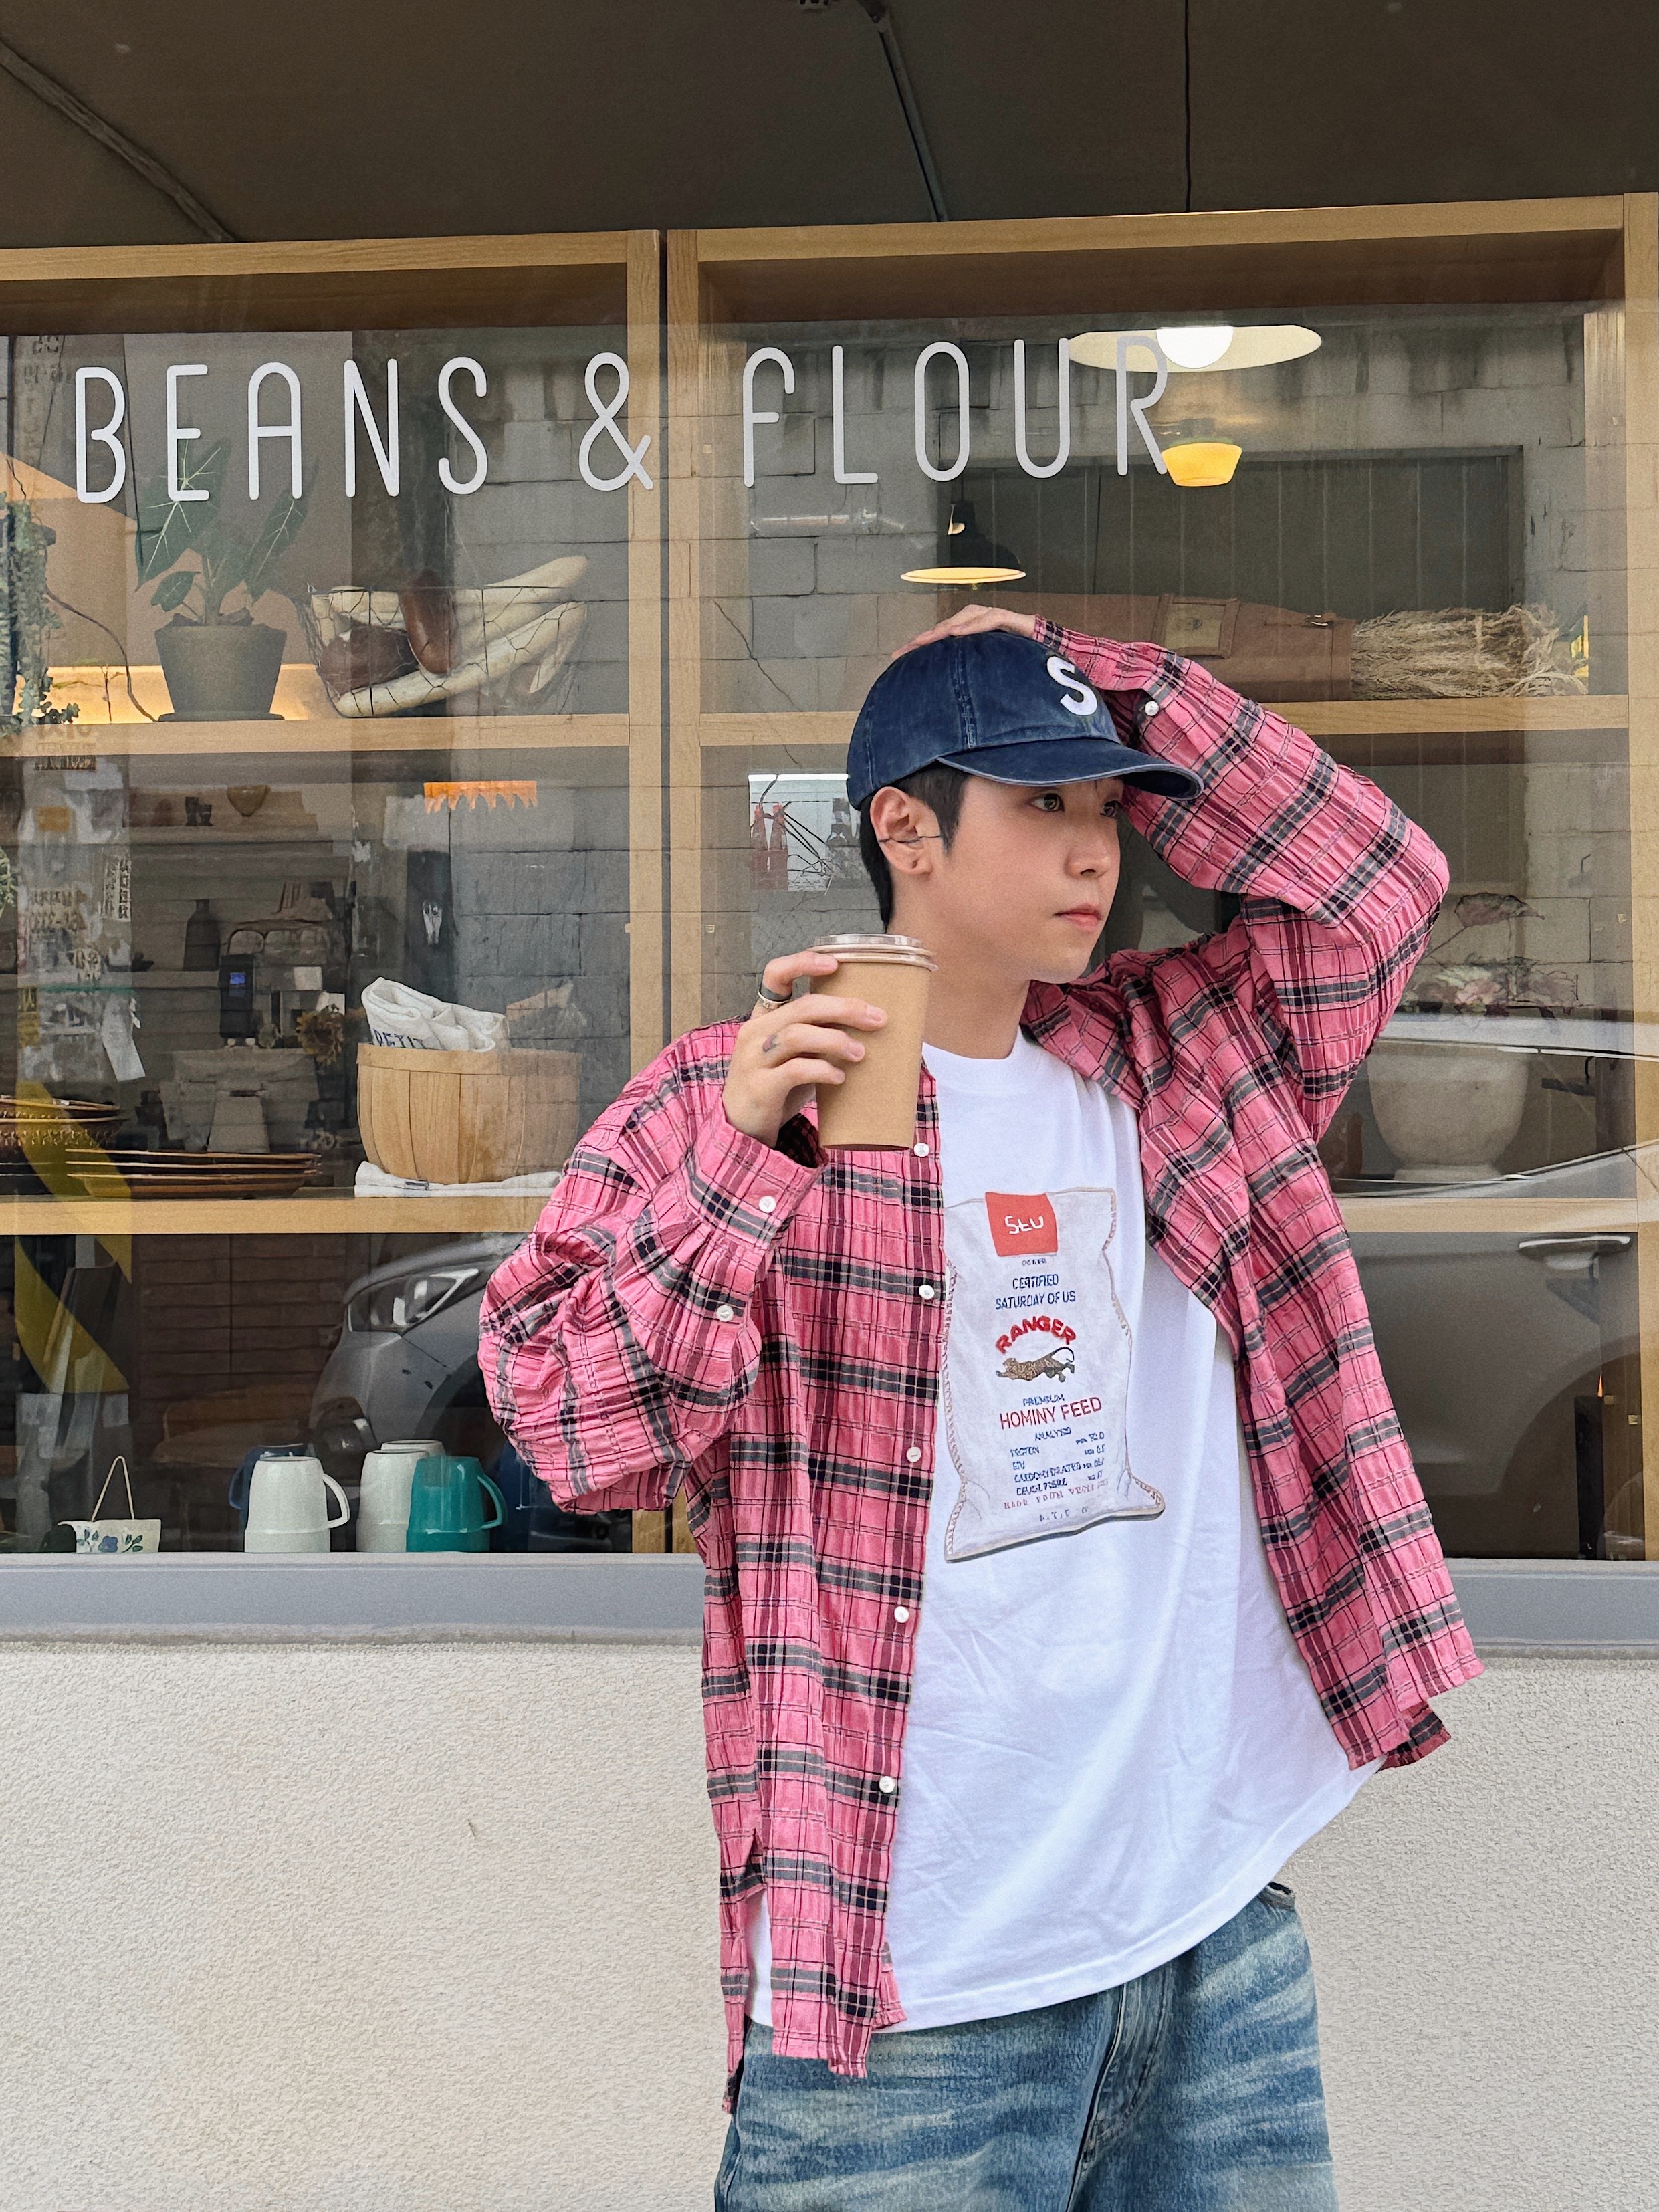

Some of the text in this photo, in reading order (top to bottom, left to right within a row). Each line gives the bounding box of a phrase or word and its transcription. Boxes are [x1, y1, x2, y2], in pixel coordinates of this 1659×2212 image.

[75, 334, 1168, 504] BEANS & FLOUR
[1046, 655, 1097, 715] S
[995, 1290, 1076, 1310] SATURDAY OF US
[1012, 1274, 1059, 1290] CERTIFIED
[995, 1315, 1076, 1355] RANGER
[1000, 1397, 1102, 1430] HOMINY FEED
